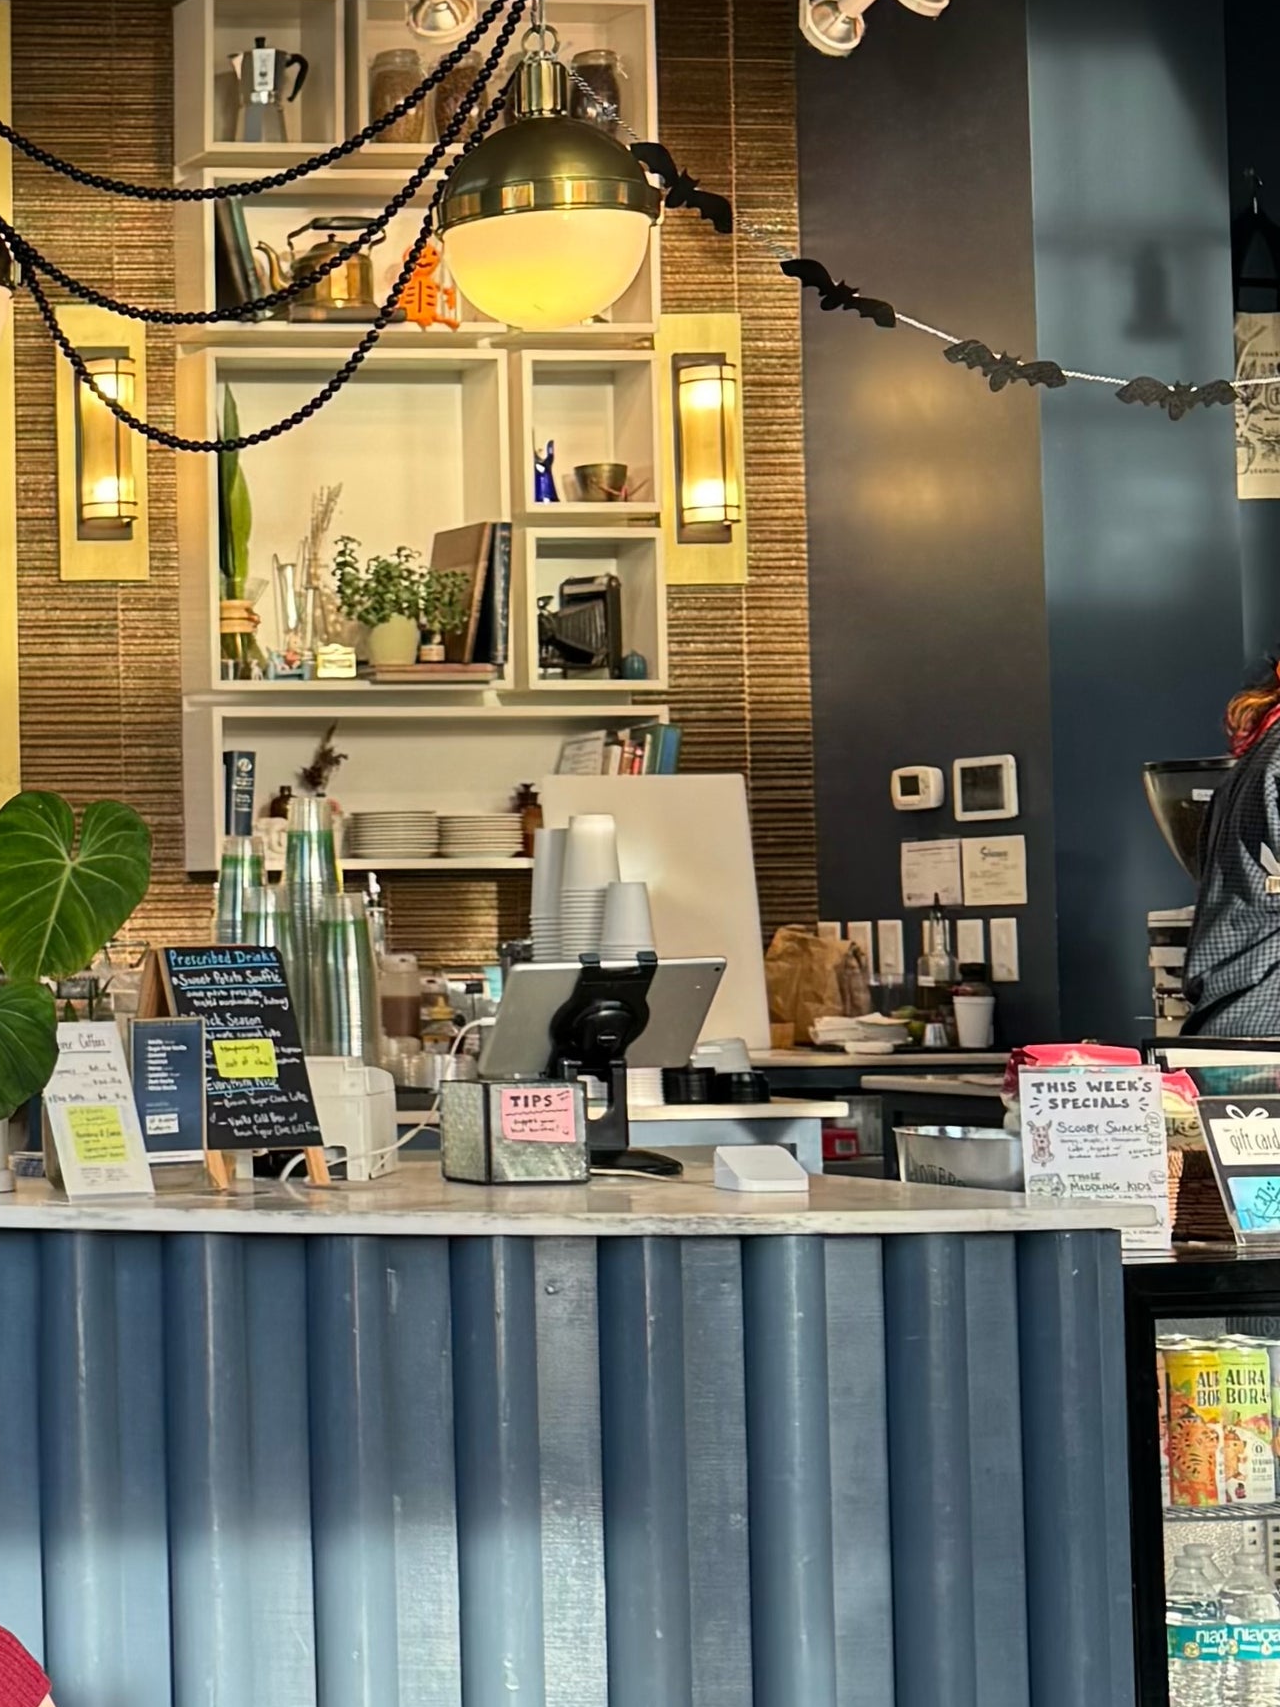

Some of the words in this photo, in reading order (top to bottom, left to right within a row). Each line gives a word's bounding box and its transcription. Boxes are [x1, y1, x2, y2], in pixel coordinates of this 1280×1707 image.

[169, 949, 232, 967] Prescribed
[234, 949, 278, 964] Drinks
[177, 973, 211, 987] Sweet
[225, 1011, 262, 1027] Season
[1031, 1081, 1077, 1094] THIS
[1086, 1077, 1153, 1093] WEEK'S
[509, 1095, 553, 1108] TIPS
[1048, 1096, 1130, 1110] SPECIALS
[1229, 1127, 1254, 1156] gift
[1225, 1368, 1266, 1386] AURA
[1225, 1387, 1268, 1405] BORA
